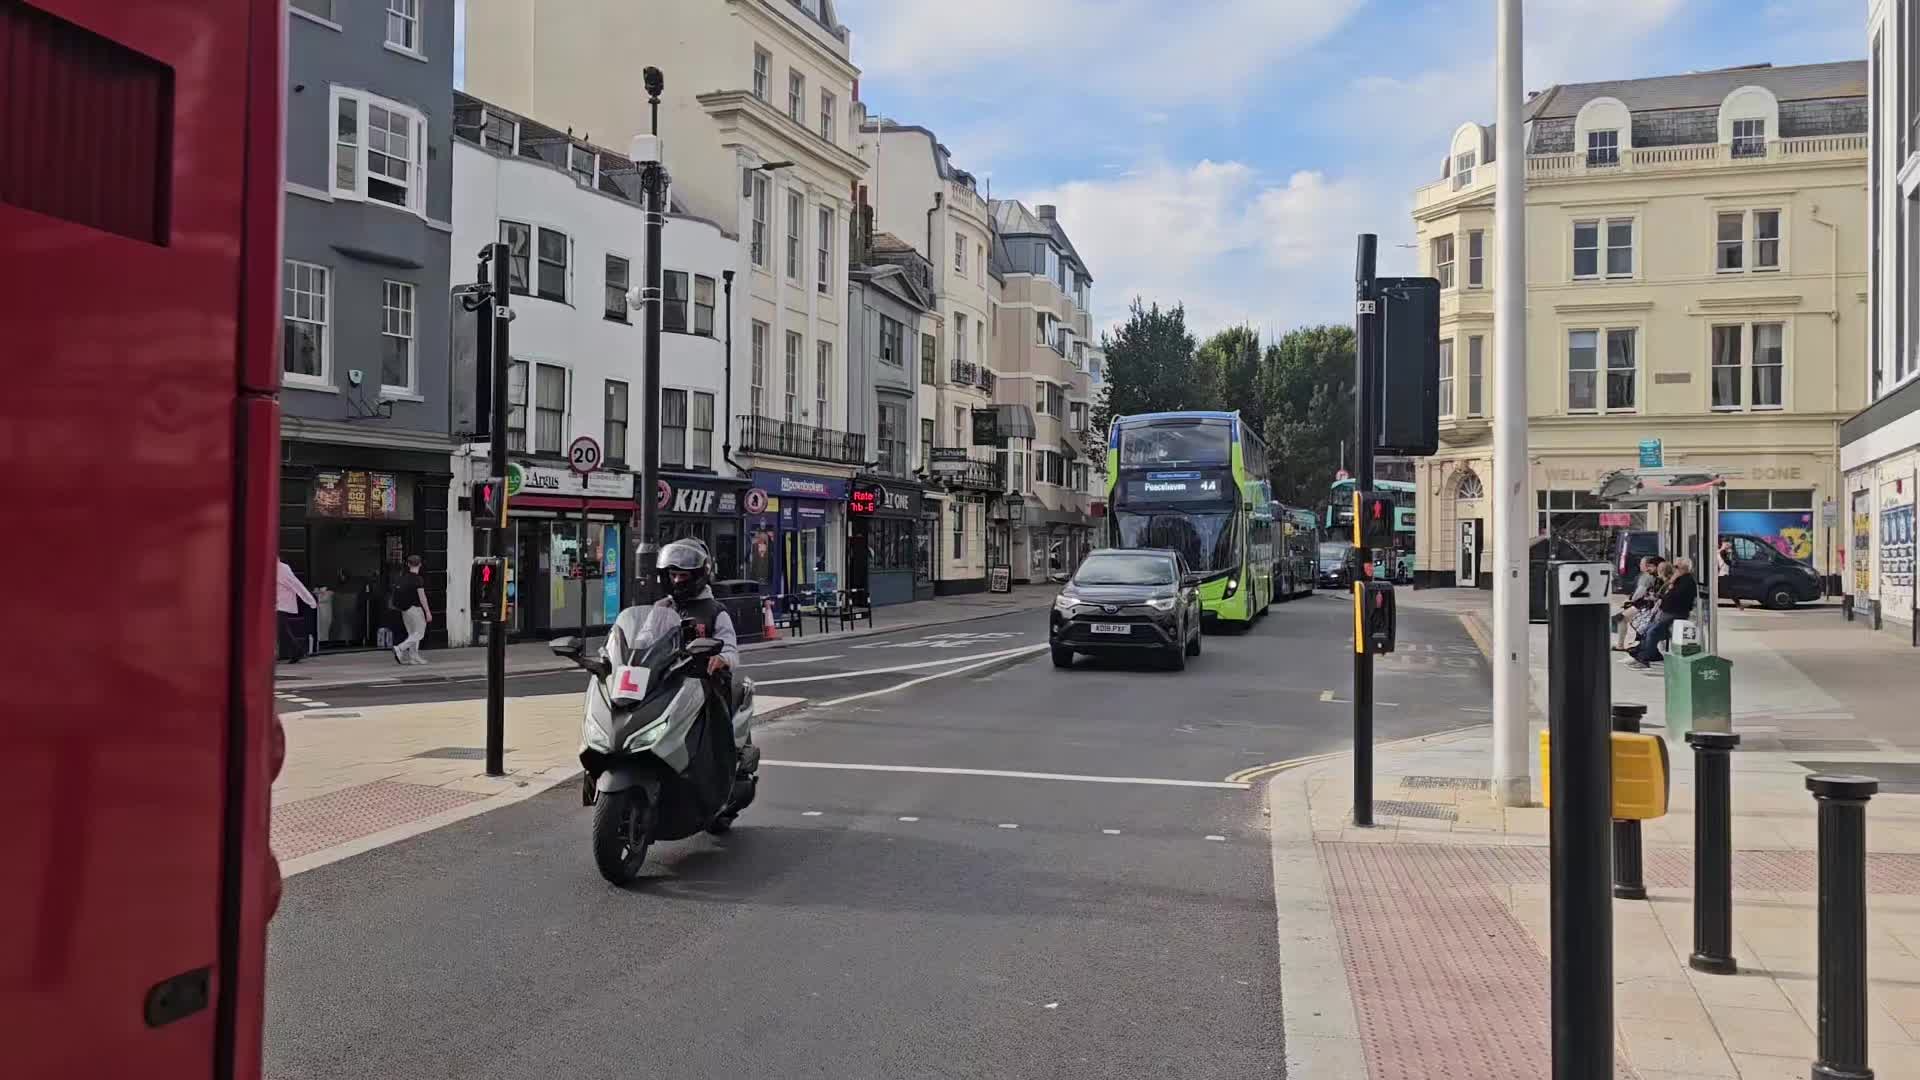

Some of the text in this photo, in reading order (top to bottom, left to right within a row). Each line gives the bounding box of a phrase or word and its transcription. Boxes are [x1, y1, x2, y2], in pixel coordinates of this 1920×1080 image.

[573, 447, 597, 463] 20
[531, 472, 559, 487] Argus
[1544, 467, 1590, 481] WELL
[1752, 467, 1801, 480] DONE
[673, 488, 715, 513] KHF
[1569, 569, 1610, 598] 27
[620, 670, 639, 692] L
